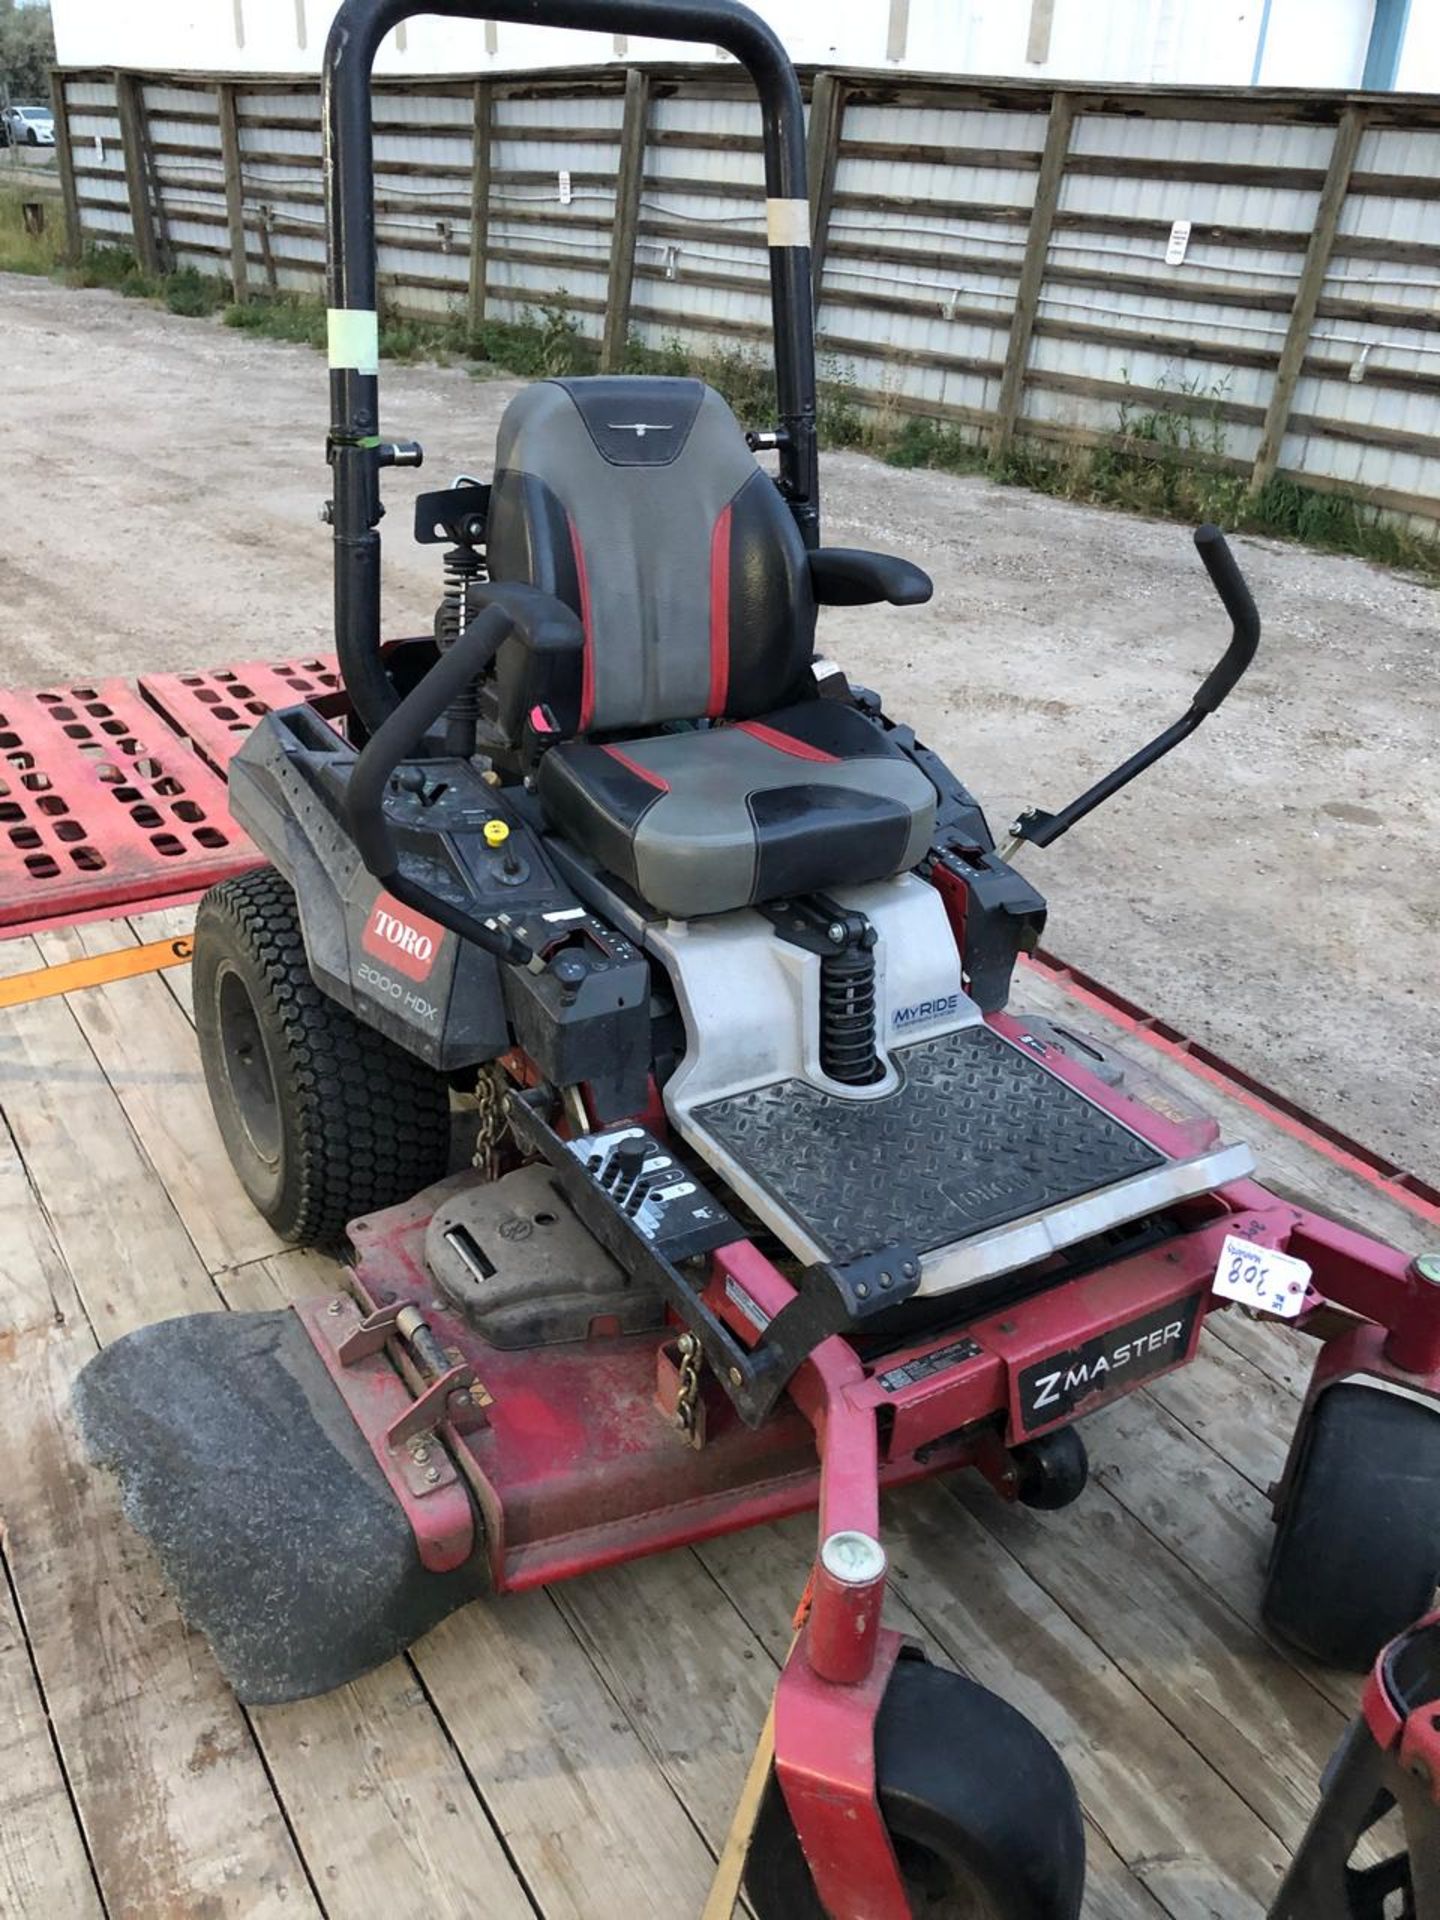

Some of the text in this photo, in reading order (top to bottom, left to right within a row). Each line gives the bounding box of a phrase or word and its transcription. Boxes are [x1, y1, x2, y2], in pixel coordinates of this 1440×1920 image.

[373, 909, 433, 960] TORO
[357, 963, 438, 1020] 2000 HDX
